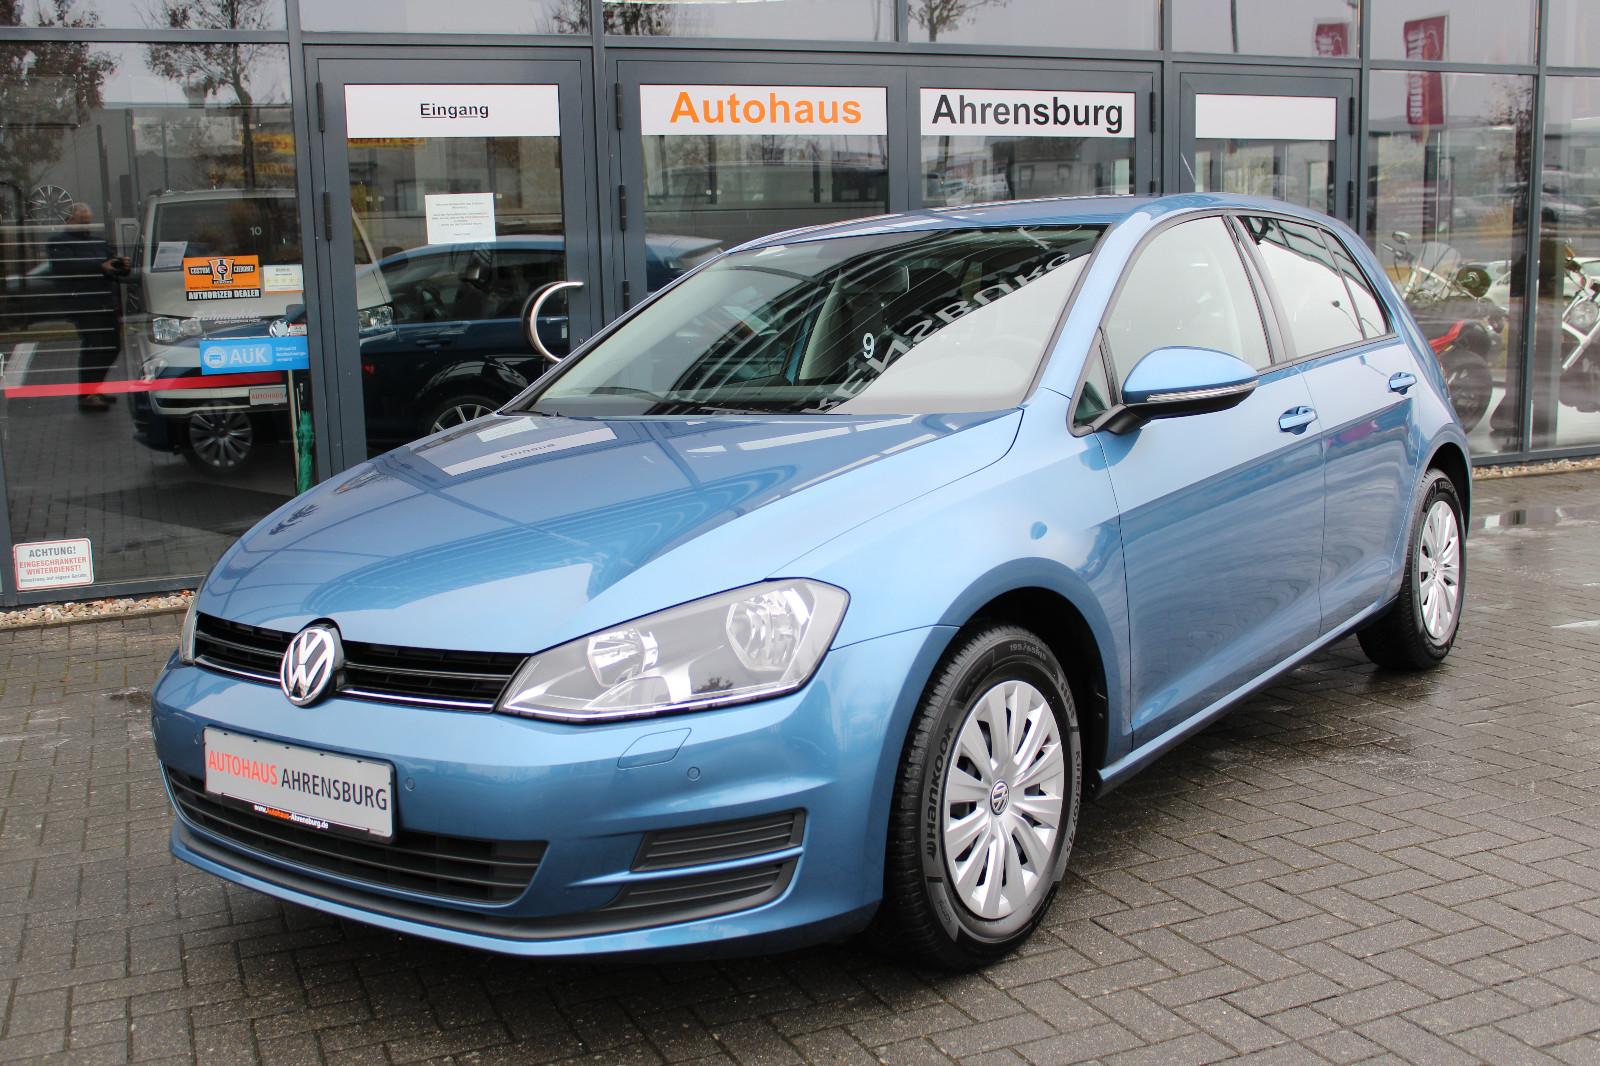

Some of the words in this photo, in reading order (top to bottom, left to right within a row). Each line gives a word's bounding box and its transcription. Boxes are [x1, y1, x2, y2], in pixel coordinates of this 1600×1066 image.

[419, 102, 490, 120] Eingang
[670, 91, 862, 124] Autohaus
[932, 94, 1125, 134] Ahrensburg
[188, 290, 233, 300] AUTHORIZED
[234, 289, 260, 298] DEALER
[229, 346, 268, 365] AÜK
[862, 333, 875, 359] 9
[29, 546, 76, 558] ACHTUNG!
[26, 565, 81, 576] WINTERDIENST!
[208, 750, 278, 786] AUTOHAUS
[281, 768, 387, 811] AHRENSBURG
[254, 804, 329, 829] www.Autohaus-Ahrensburg.de
